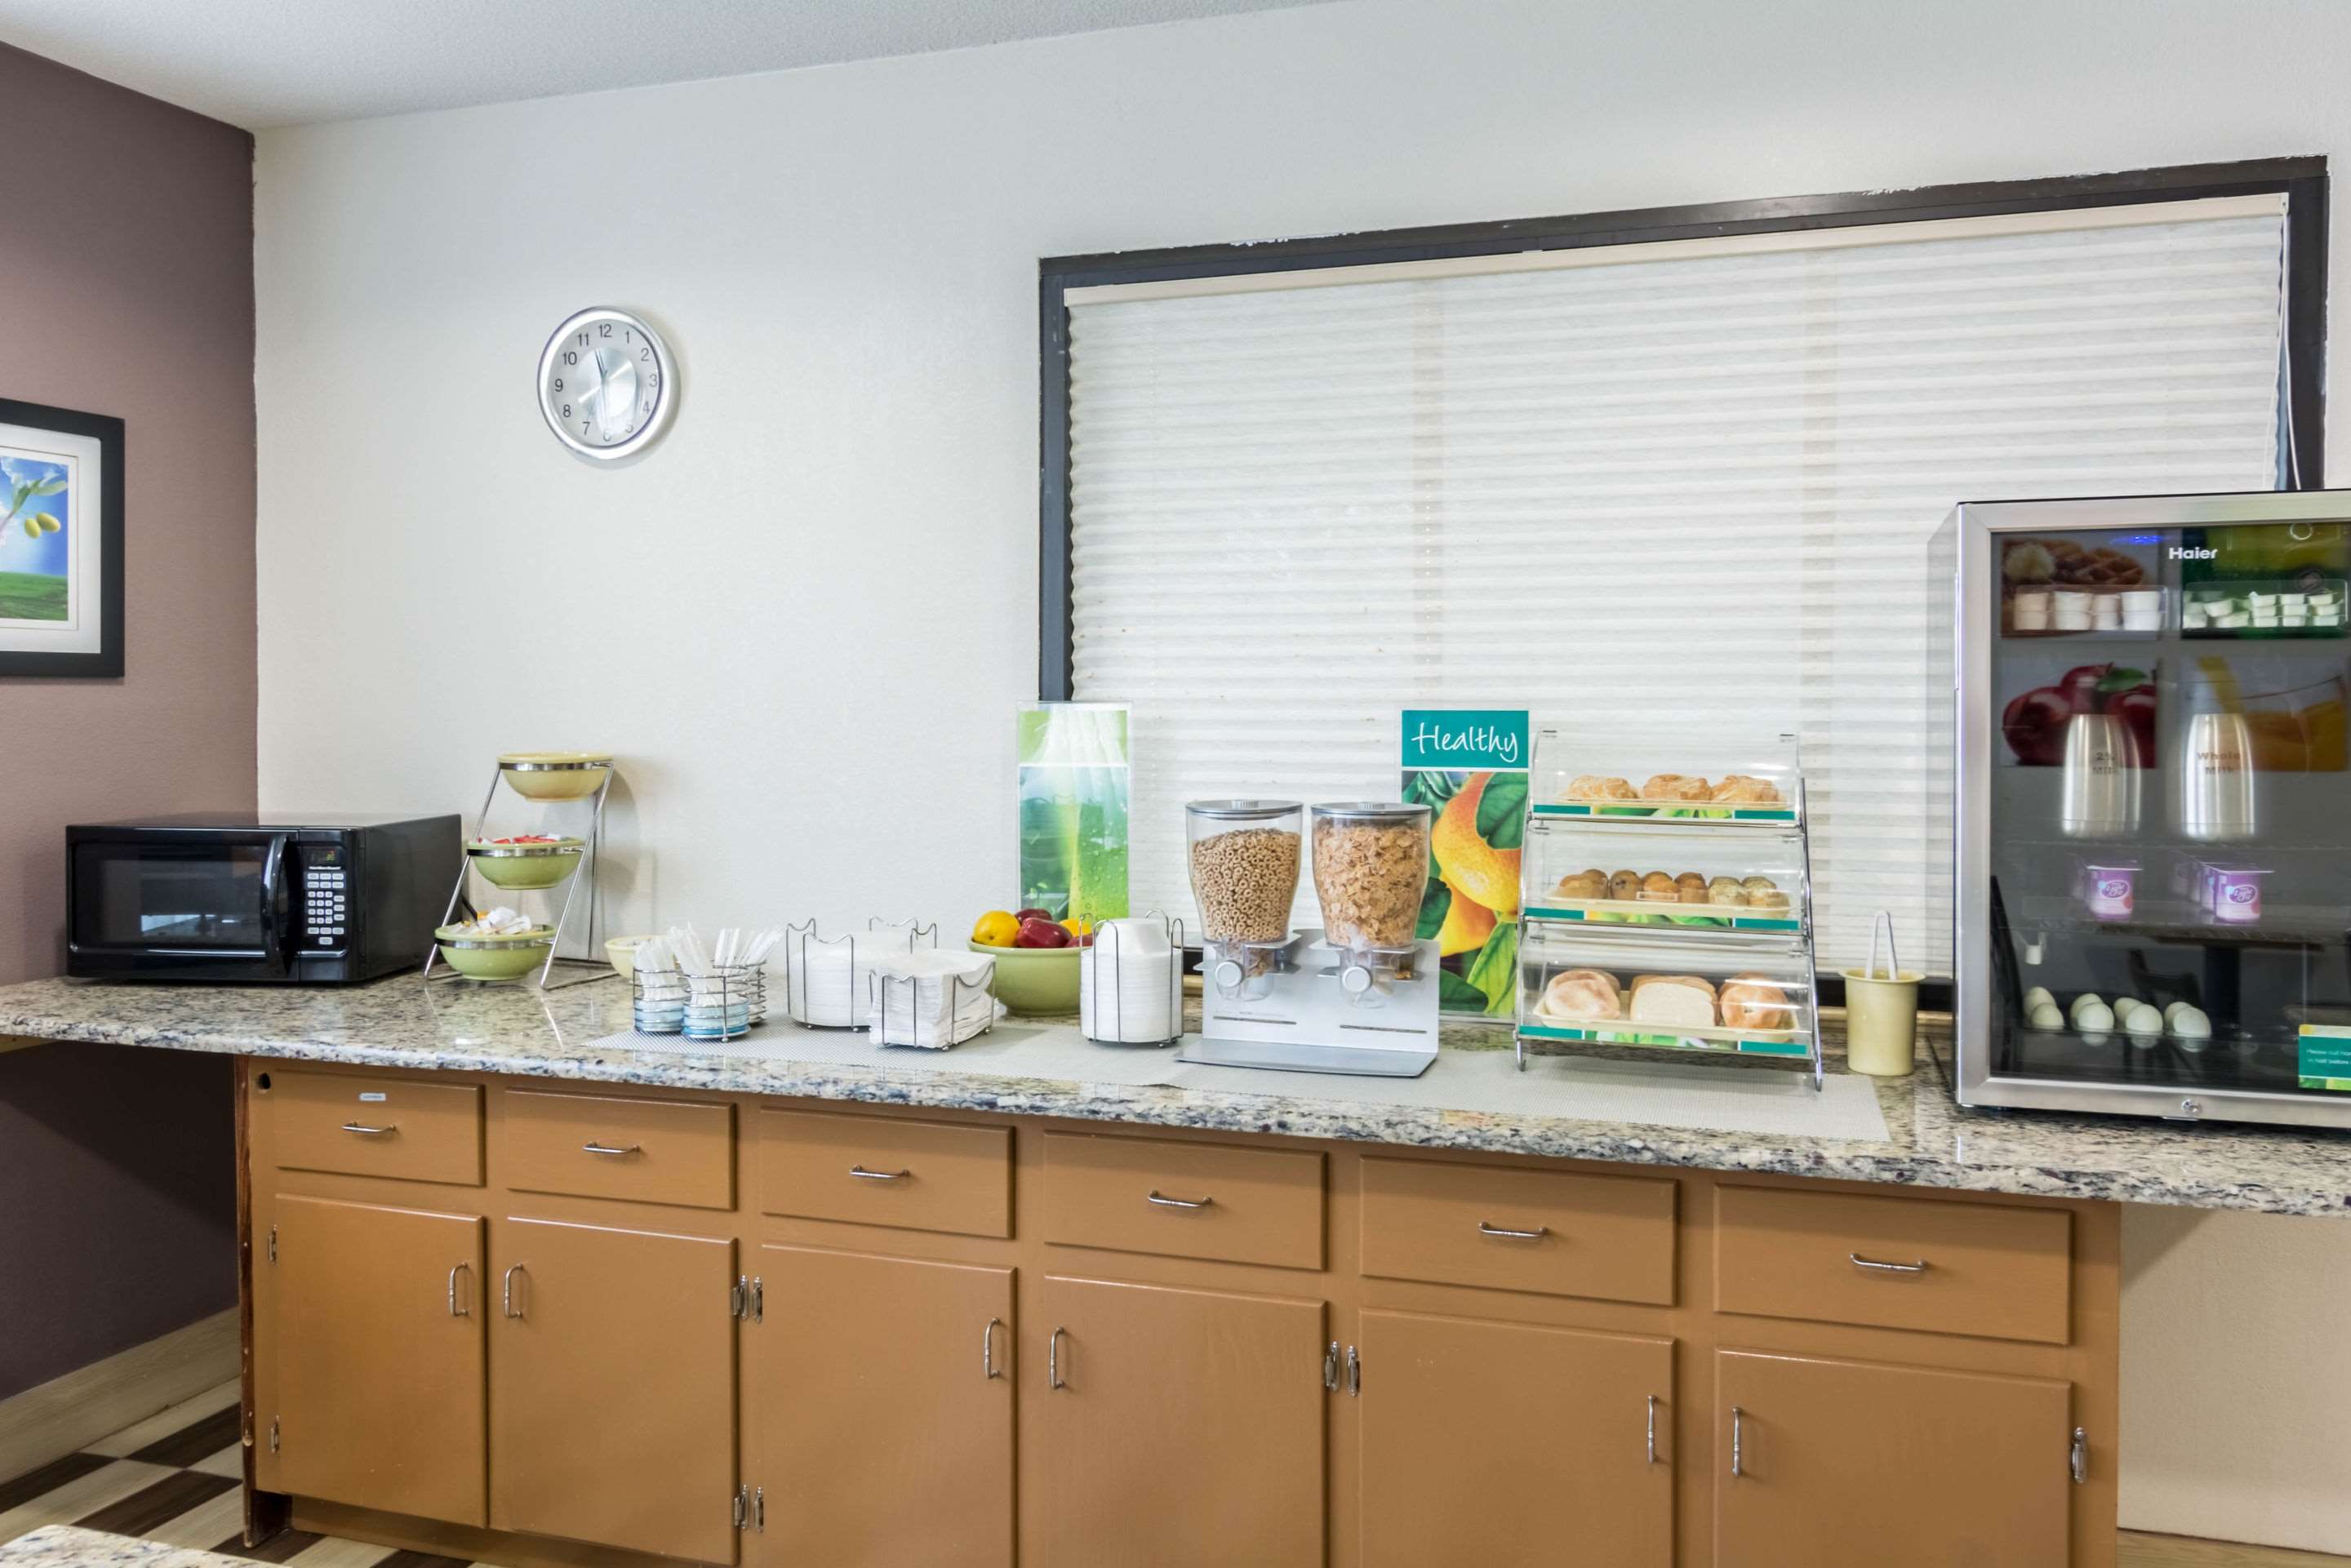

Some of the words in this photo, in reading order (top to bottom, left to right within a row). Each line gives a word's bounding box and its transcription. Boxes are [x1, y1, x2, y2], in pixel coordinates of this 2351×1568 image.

[598, 324, 612, 337] 12
[578, 334, 589, 347] 11
[562, 352, 577, 365] 10
[641, 348, 650, 362] 2
[554, 378, 563, 392] 9
[650, 374, 657, 388] 3
[563, 404, 571, 418] 8
[642, 401, 651, 414] 4
[582, 421, 590, 435] 7
[2168, 547, 2218, 560] Haier
[1411, 722, 1518, 762] Healthy
[2196, 750, 2241, 760] Whole
